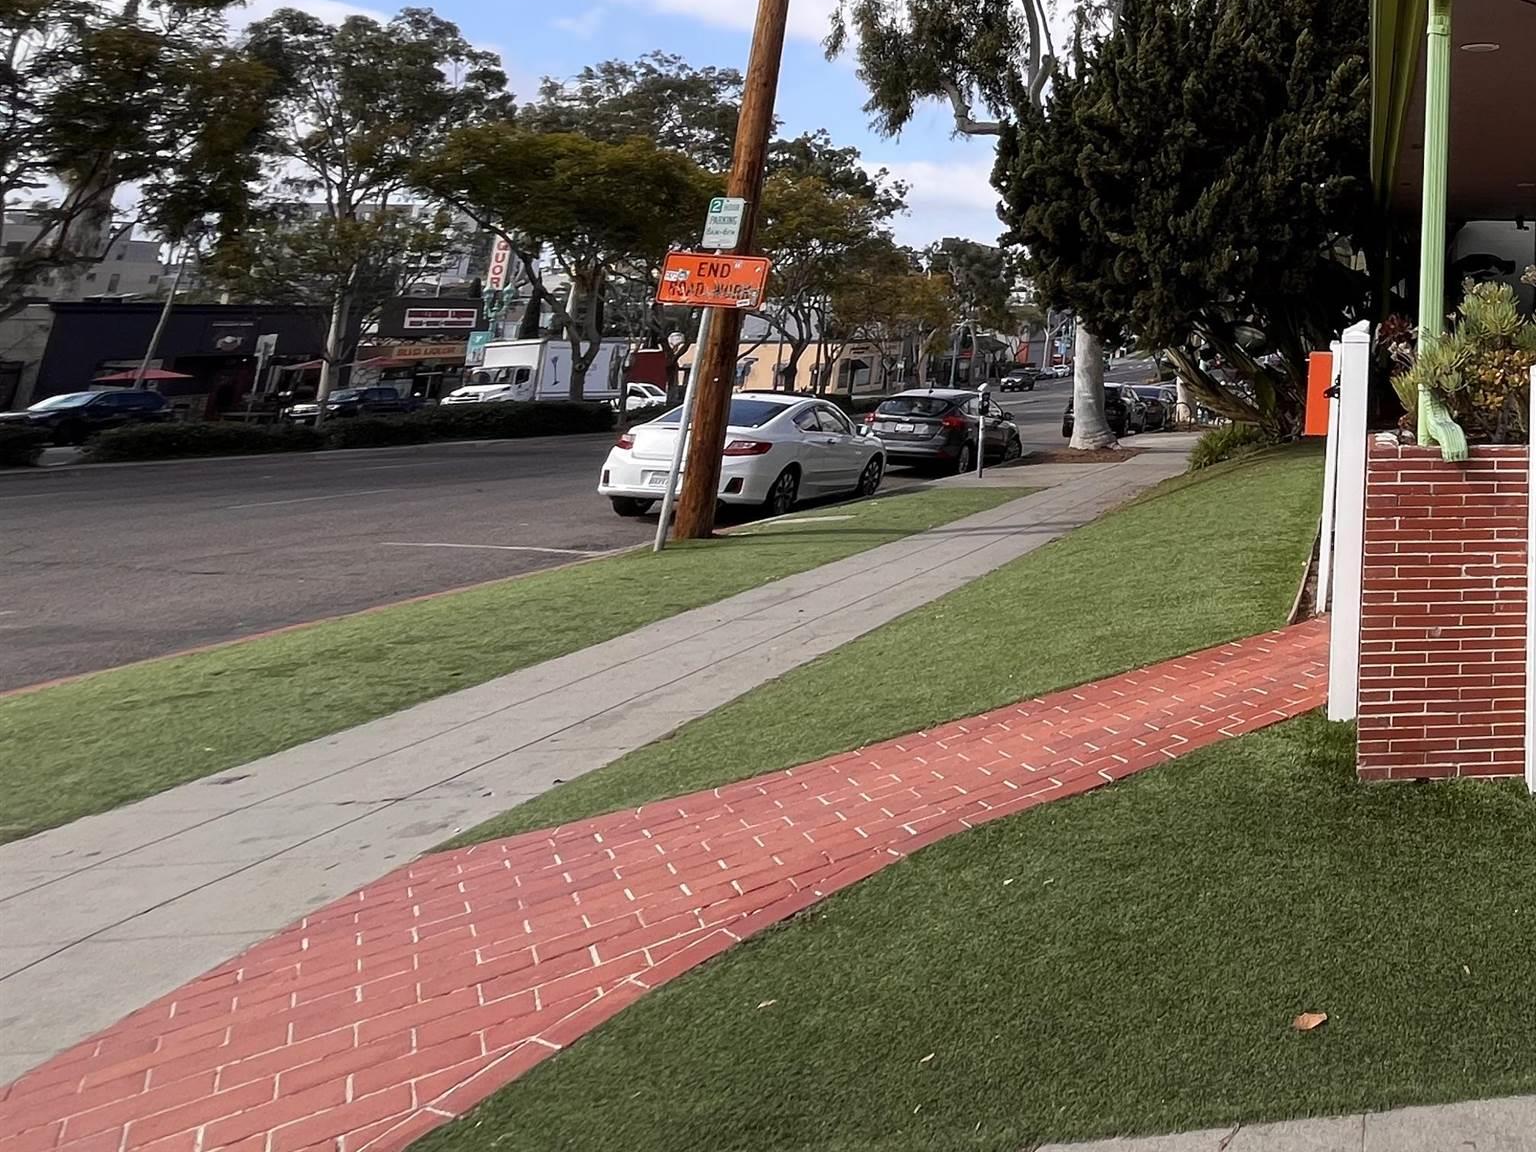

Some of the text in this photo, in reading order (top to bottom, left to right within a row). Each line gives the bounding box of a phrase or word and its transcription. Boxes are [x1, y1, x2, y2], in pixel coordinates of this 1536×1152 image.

[711, 200, 722, 212] 2
[709, 215, 739, 226] PARKING
[490, 240, 509, 288] QUOR
[697, 261, 732, 279] END
